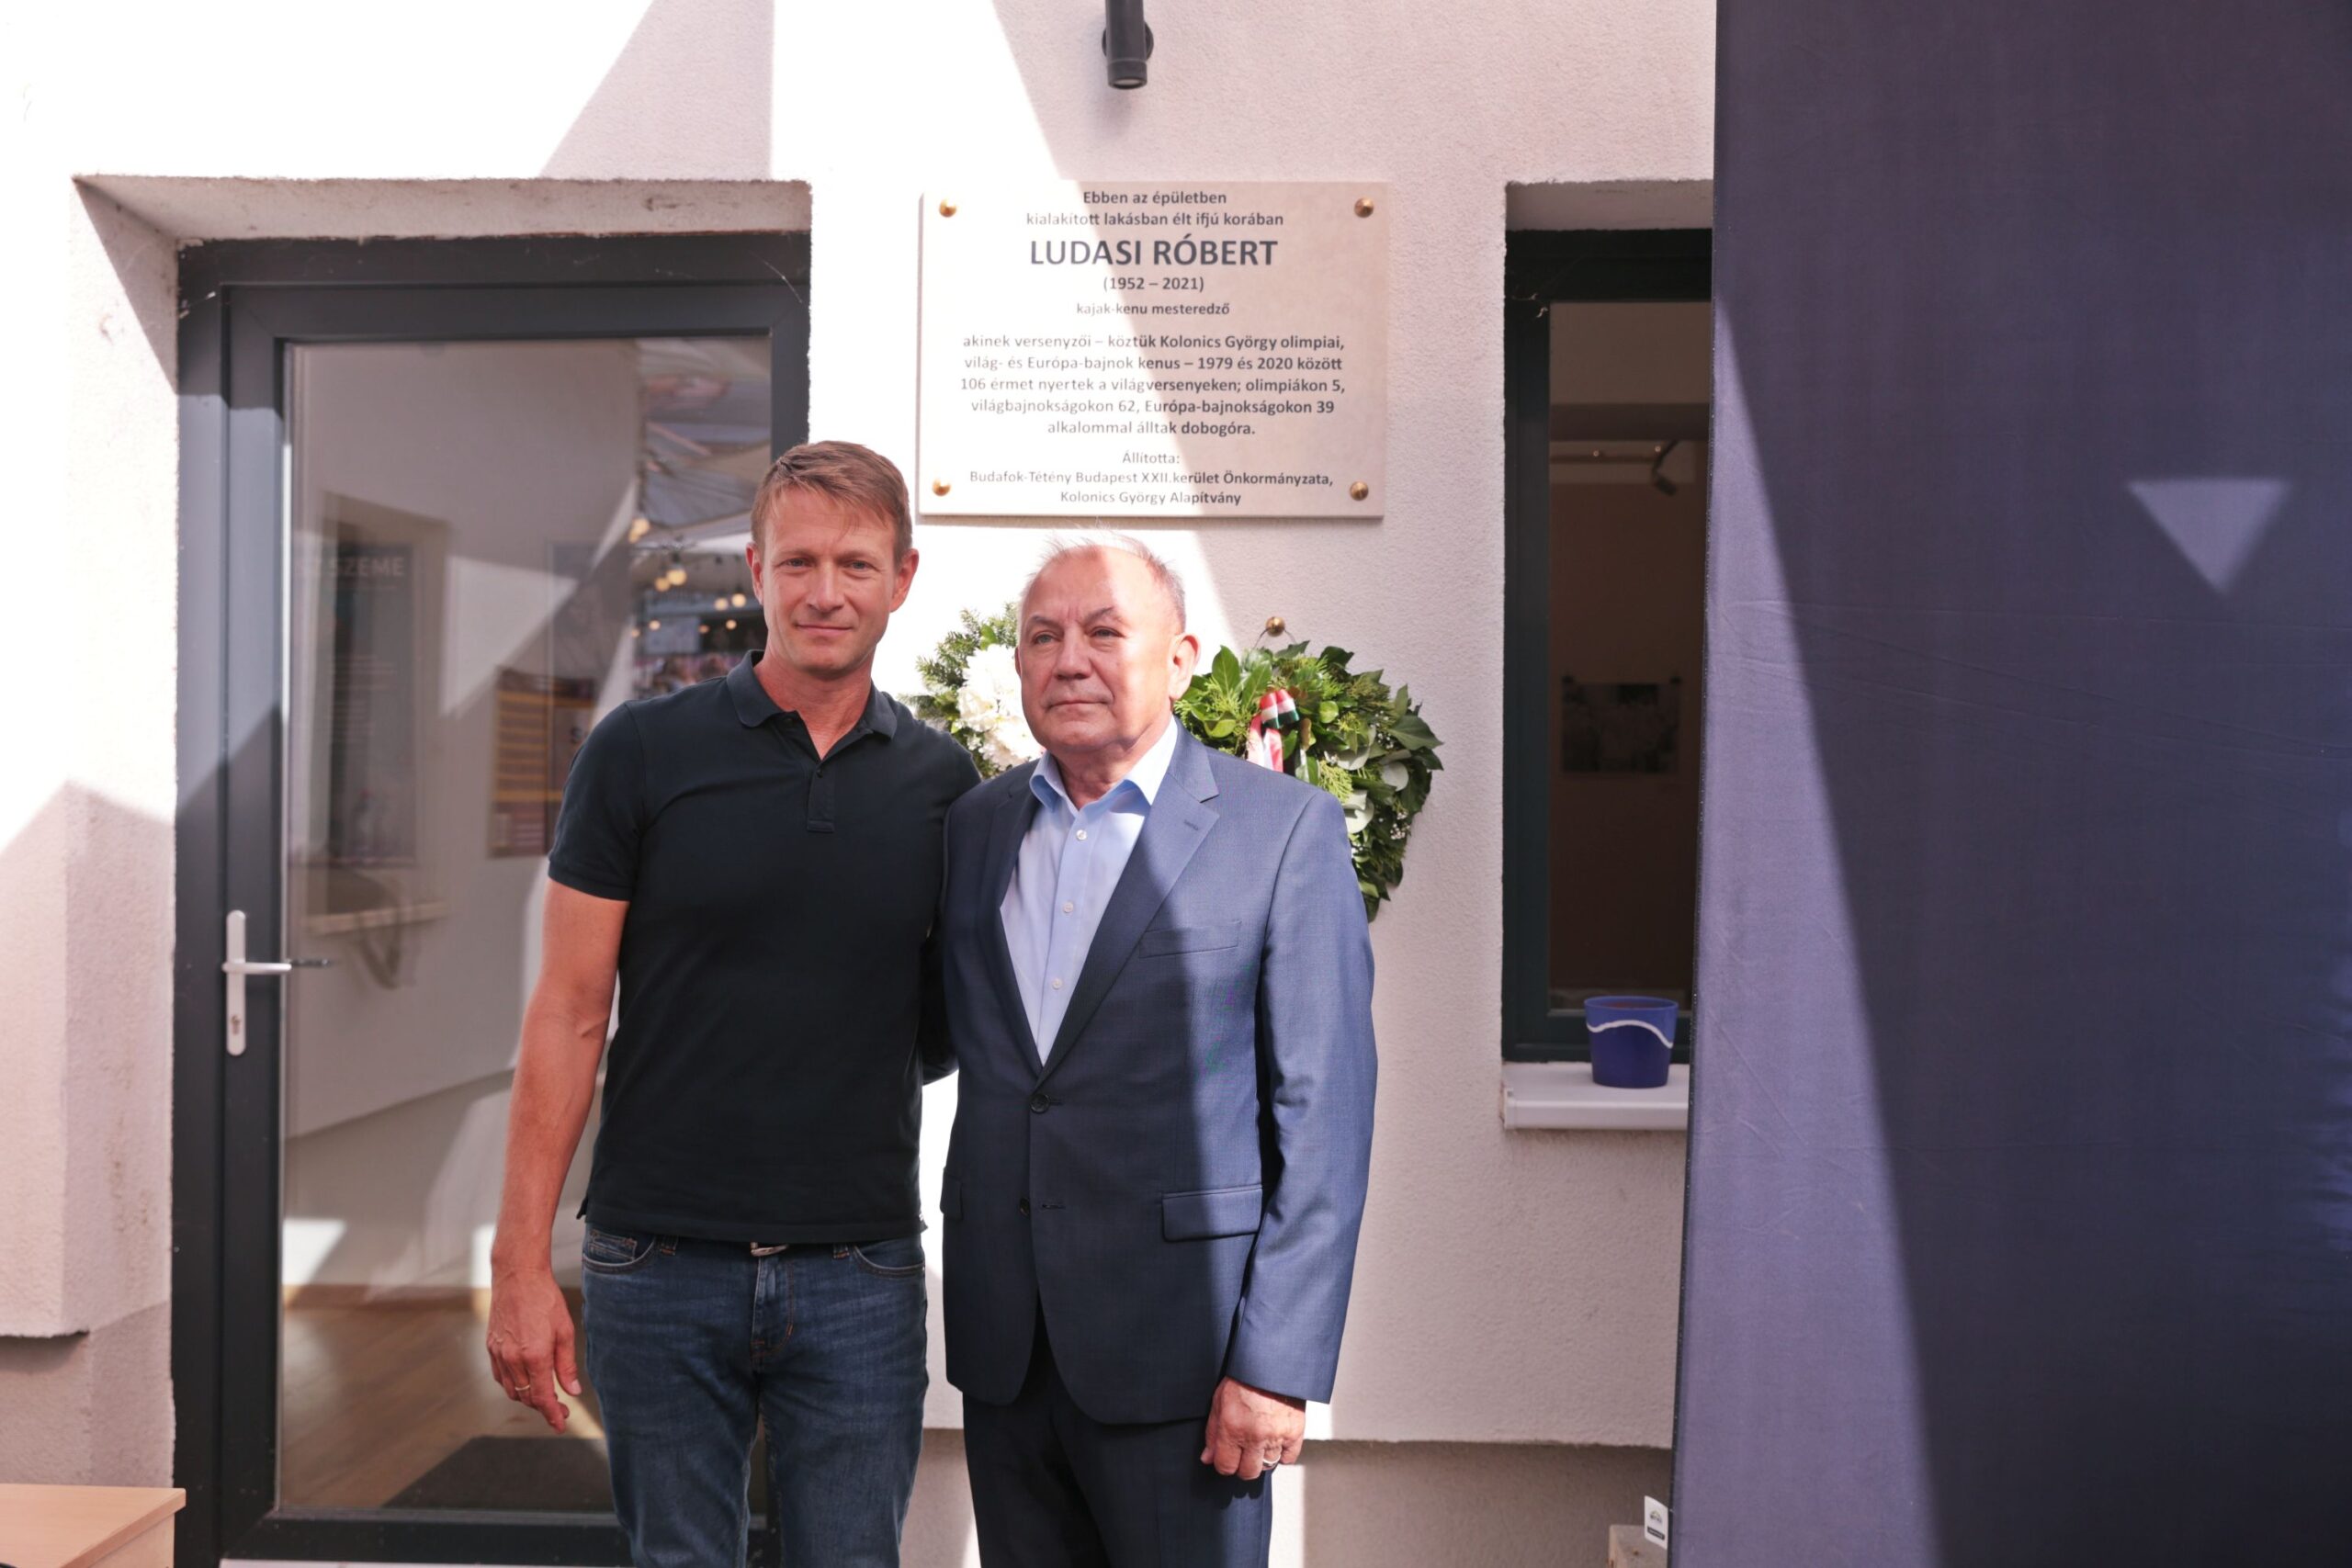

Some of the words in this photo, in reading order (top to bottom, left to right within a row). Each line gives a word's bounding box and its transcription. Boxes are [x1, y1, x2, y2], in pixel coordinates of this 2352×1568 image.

[1082, 190, 1129, 205] Ebben
[1132, 193, 1148, 205] az
[1151, 190, 1227, 208] épületben
[1026, 212, 1101, 226] kialakított
[1103, 211, 1169, 226] lakásban
[1171, 211, 1193, 226] élt
[1195, 211, 1219, 229] ifjú
[1223, 211, 1284, 226] korában
[1030, 239, 1142, 266] LUDASI
[1153, 232, 1279, 266] RÓBERT
[1102, 276, 1146, 292] (1952
[1161, 276, 1204, 294] 2021)
[1076, 302, 1148, 317] kajak-kenu
[1151, 301, 1230, 316] mesteredző
[962, 333, 1011, 347] akinek
[1013, 333, 1091, 351] versenyzői
[1108, 333, 1157, 348] köztük
[1159, 333, 1222, 349] Kolonics
[1224, 334, 1278, 352] György
[1280, 334, 1345, 352] olimpiai,
[964, 355, 1003, 372] világ-
[1007, 355, 1023, 369] és
[1027, 355, 1134, 372] Európa-bajnok
[1137, 355, 1182, 370] kenus
[1197, 356, 1234, 370] 1979
[1236, 355, 1254, 370] és
[1256, 356, 1294, 371] 2020
[1296, 355, 1343, 371] között
[960, 377, 987, 390] 106
[989, 377, 1034, 390] érmet
[1038, 377, 1095, 394] nyertek
[1098, 380, 1107, 391] a
[1111, 378, 1241, 395] világversenyeken;
[1245, 378, 1329, 395] olimpiákon
[1331, 378, 1346, 395] 5,
[970, 398, 1114, 415] világbajnokságokon
[1118, 400, 1140, 414] 62,
[1145, 399, 1313, 417] Európa-bajnokságokon
[1316, 400, 1335, 414] 39
[1047, 420, 1133, 434] alkalommal
[1136, 420, 1178, 434] álltak
[1180, 420, 1256, 438] dobogóra.
[1122, 449, 1181, 465] Állította:
[969, 469, 1072, 486] Budafok-Tétény
[1075, 470, 1138, 486] Budapest
[1222, 469, 1334, 488] Önkormányzata,
[1060, 490, 1116, 503] Kolonics
[1118, 491, 1167, 506] György
[1170, 491, 1242, 507] Alapítvány
